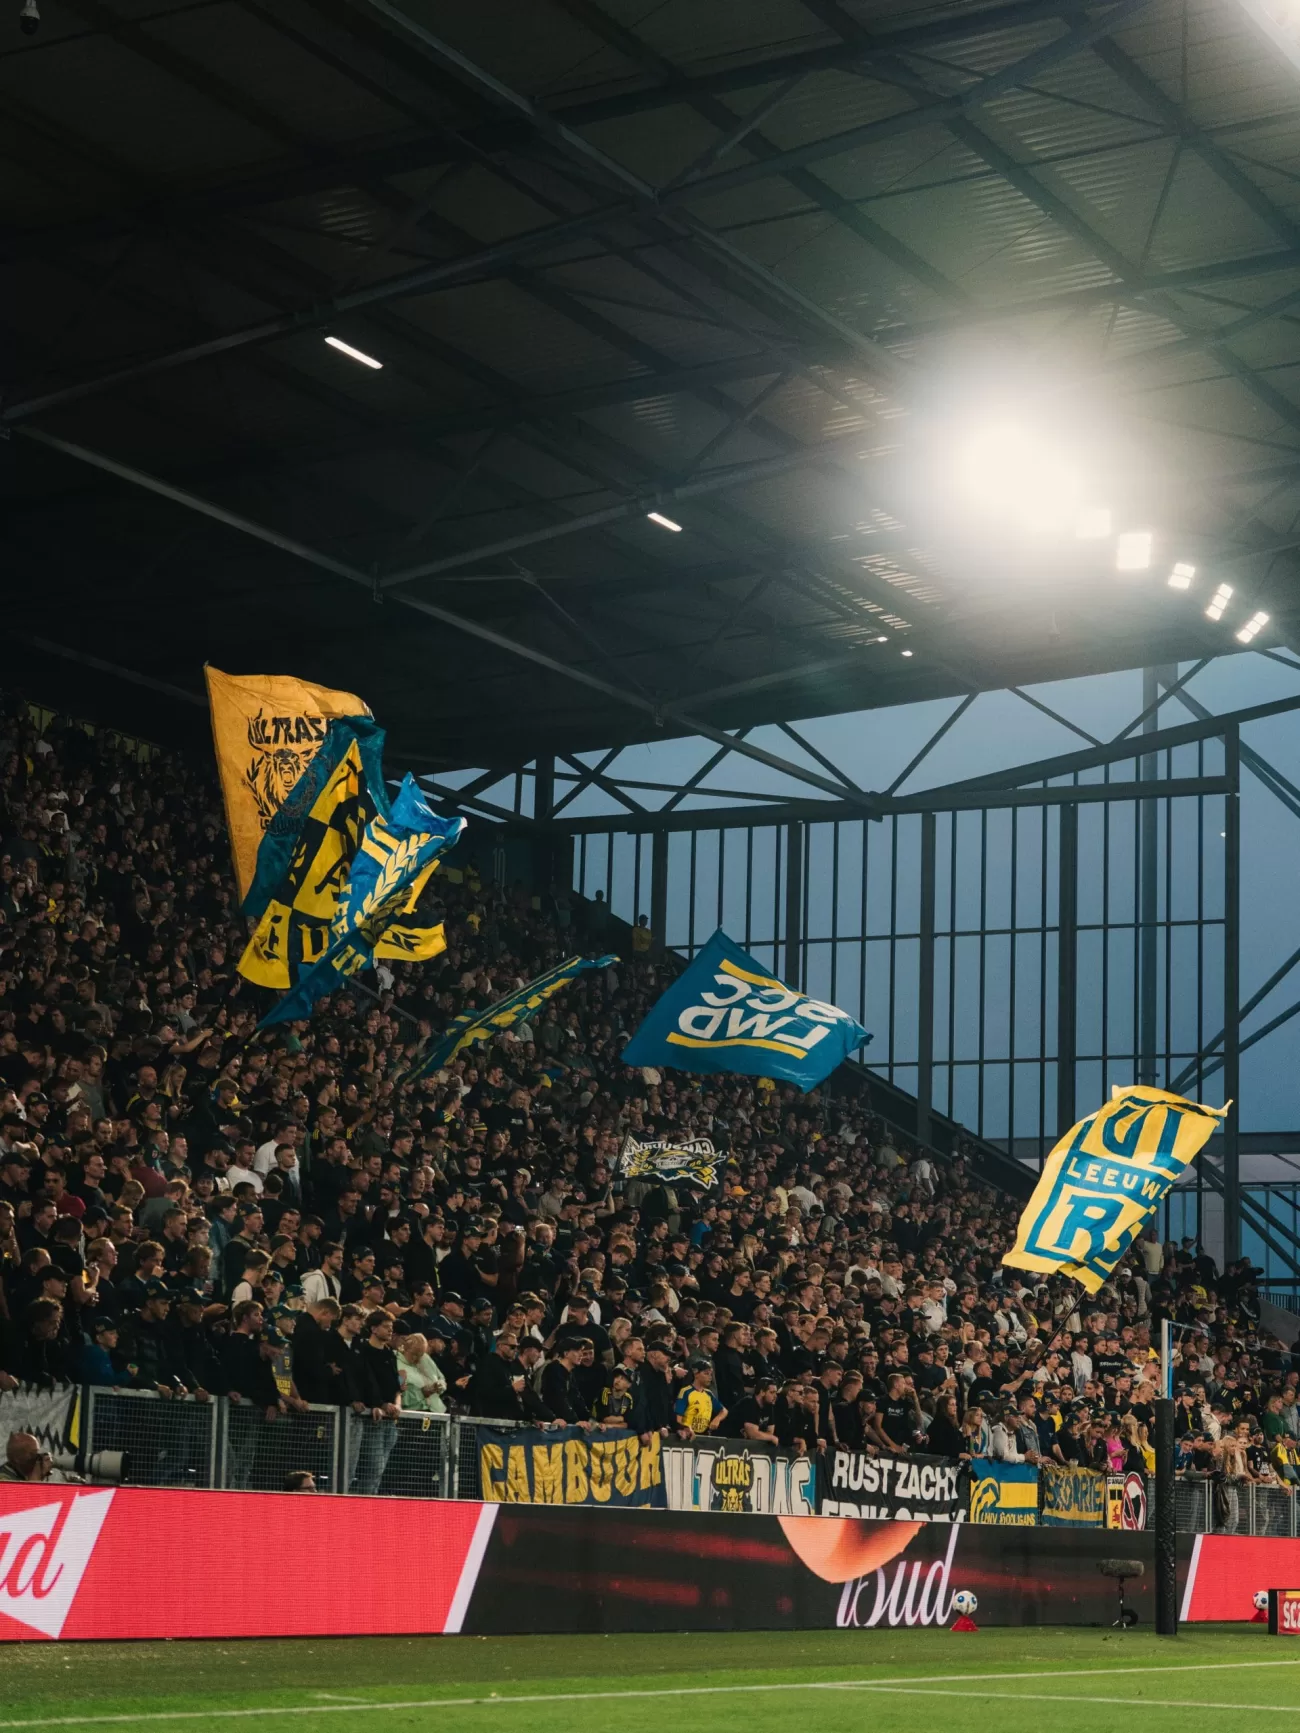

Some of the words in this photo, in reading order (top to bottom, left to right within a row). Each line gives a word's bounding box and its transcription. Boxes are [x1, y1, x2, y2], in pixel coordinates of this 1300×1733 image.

[249, 712, 326, 745] ULTRAS
[715, 1458, 751, 1486] ULTRAS
[832, 1450, 893, 1494] RUST
[1283, 1600, 1300, 1629] SC
